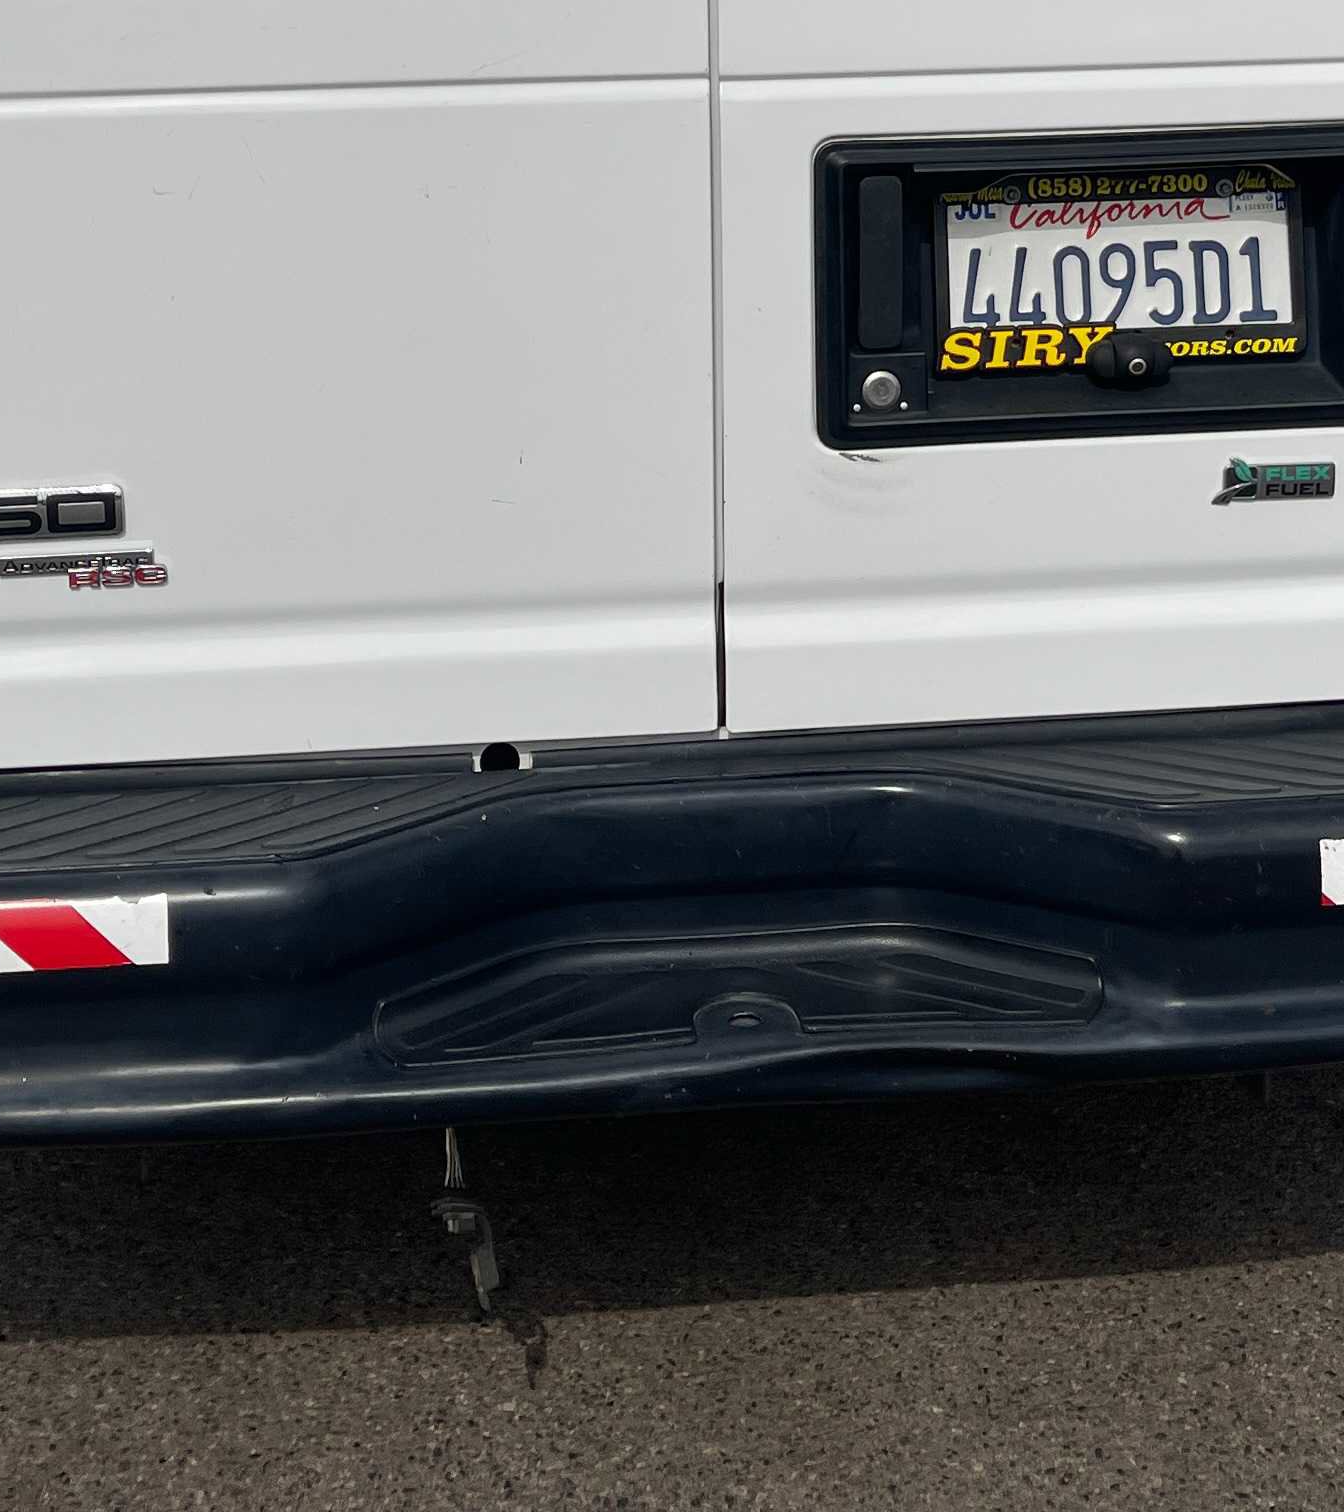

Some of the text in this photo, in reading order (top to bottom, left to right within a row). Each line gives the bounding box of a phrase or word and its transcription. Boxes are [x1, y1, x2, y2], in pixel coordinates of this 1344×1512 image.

[1028, 173, 1208, 199] (858) 277-7300
[1009, 197, 1231, 240] California
[963, 236, 1278, 327] 44095D1
[940, 326, 1115, 371] SIRY
[1165, 338, 1298, 357] ORS.COM
[1265, 464, 1330, 481] FLEX
[1264, 482, 1330, 497] FUEL
[68, 563, 168, 590] RSC
